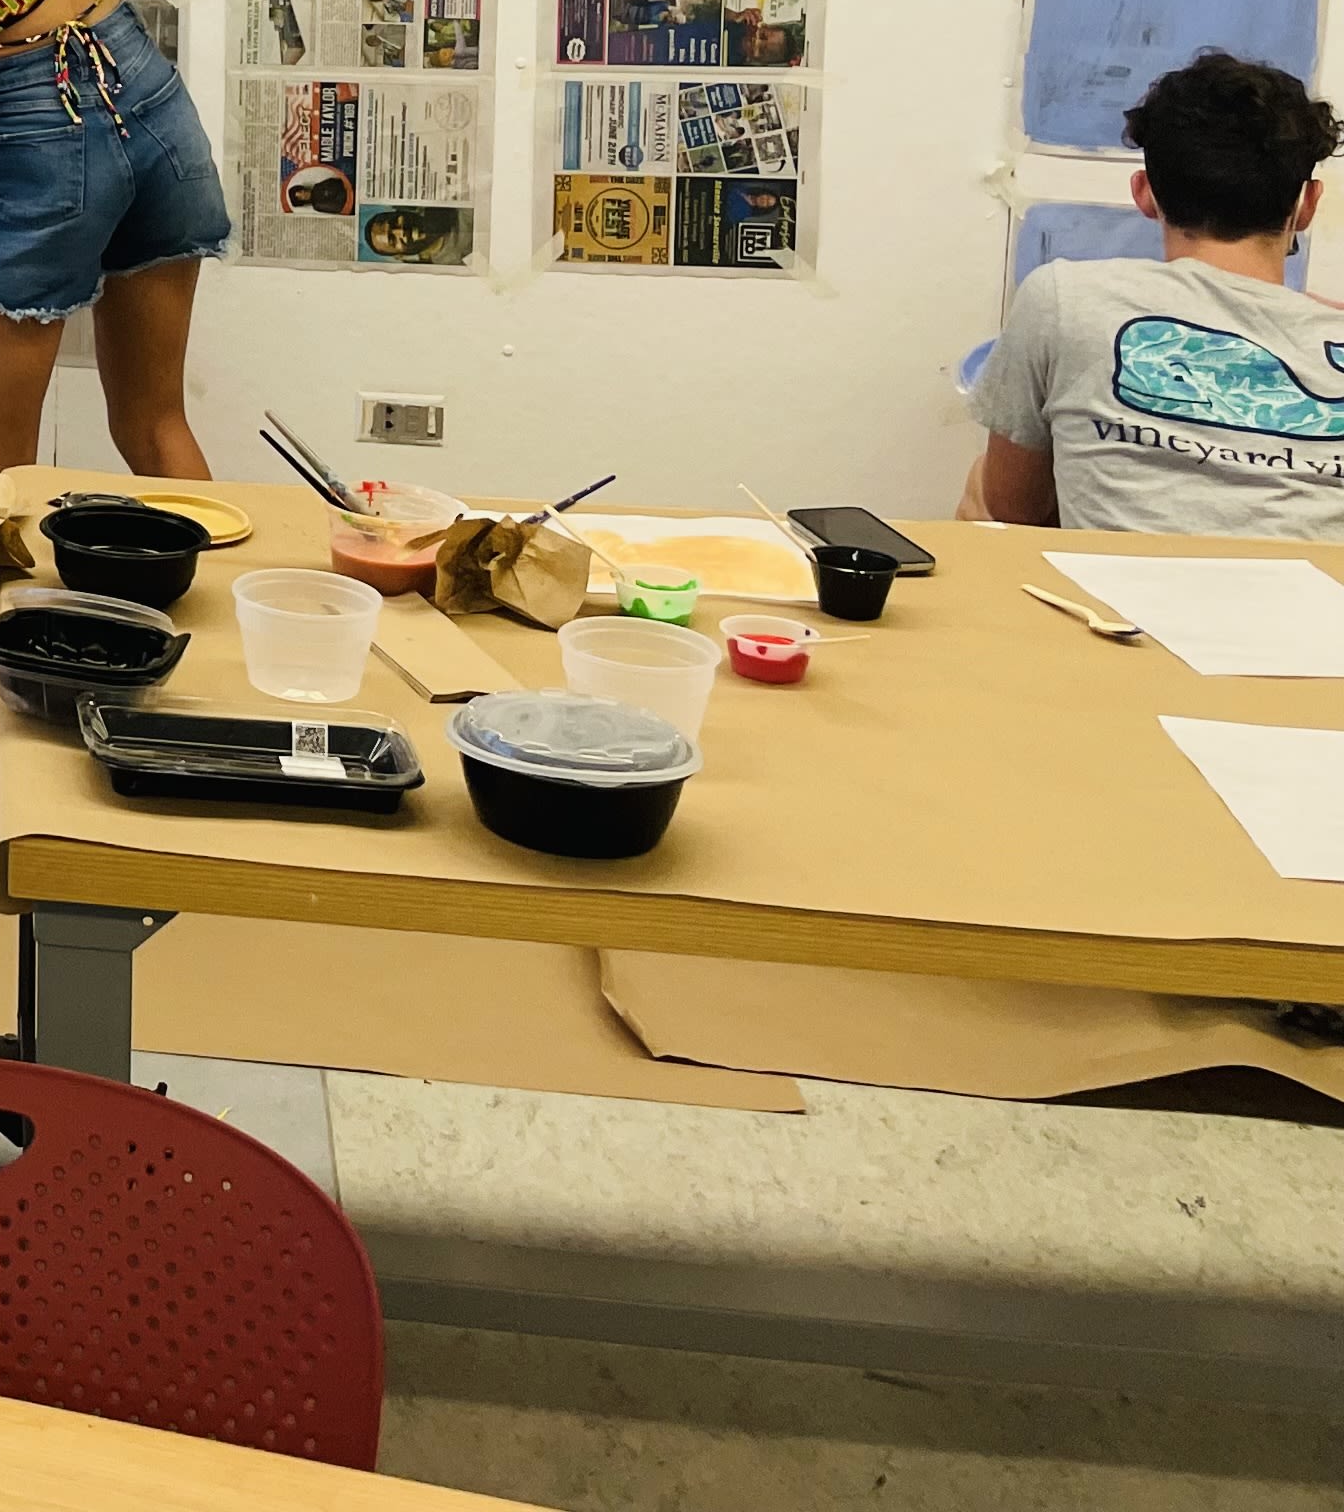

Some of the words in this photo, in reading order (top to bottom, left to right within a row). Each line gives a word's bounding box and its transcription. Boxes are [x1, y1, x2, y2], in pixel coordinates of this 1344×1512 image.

[321, 87, 336, 124] TAYLOR
[321, 128, 334, 162] MABLE
[609, 117, 617, 140] JUNE
[1092, 417, 1293, 470] vineyard
